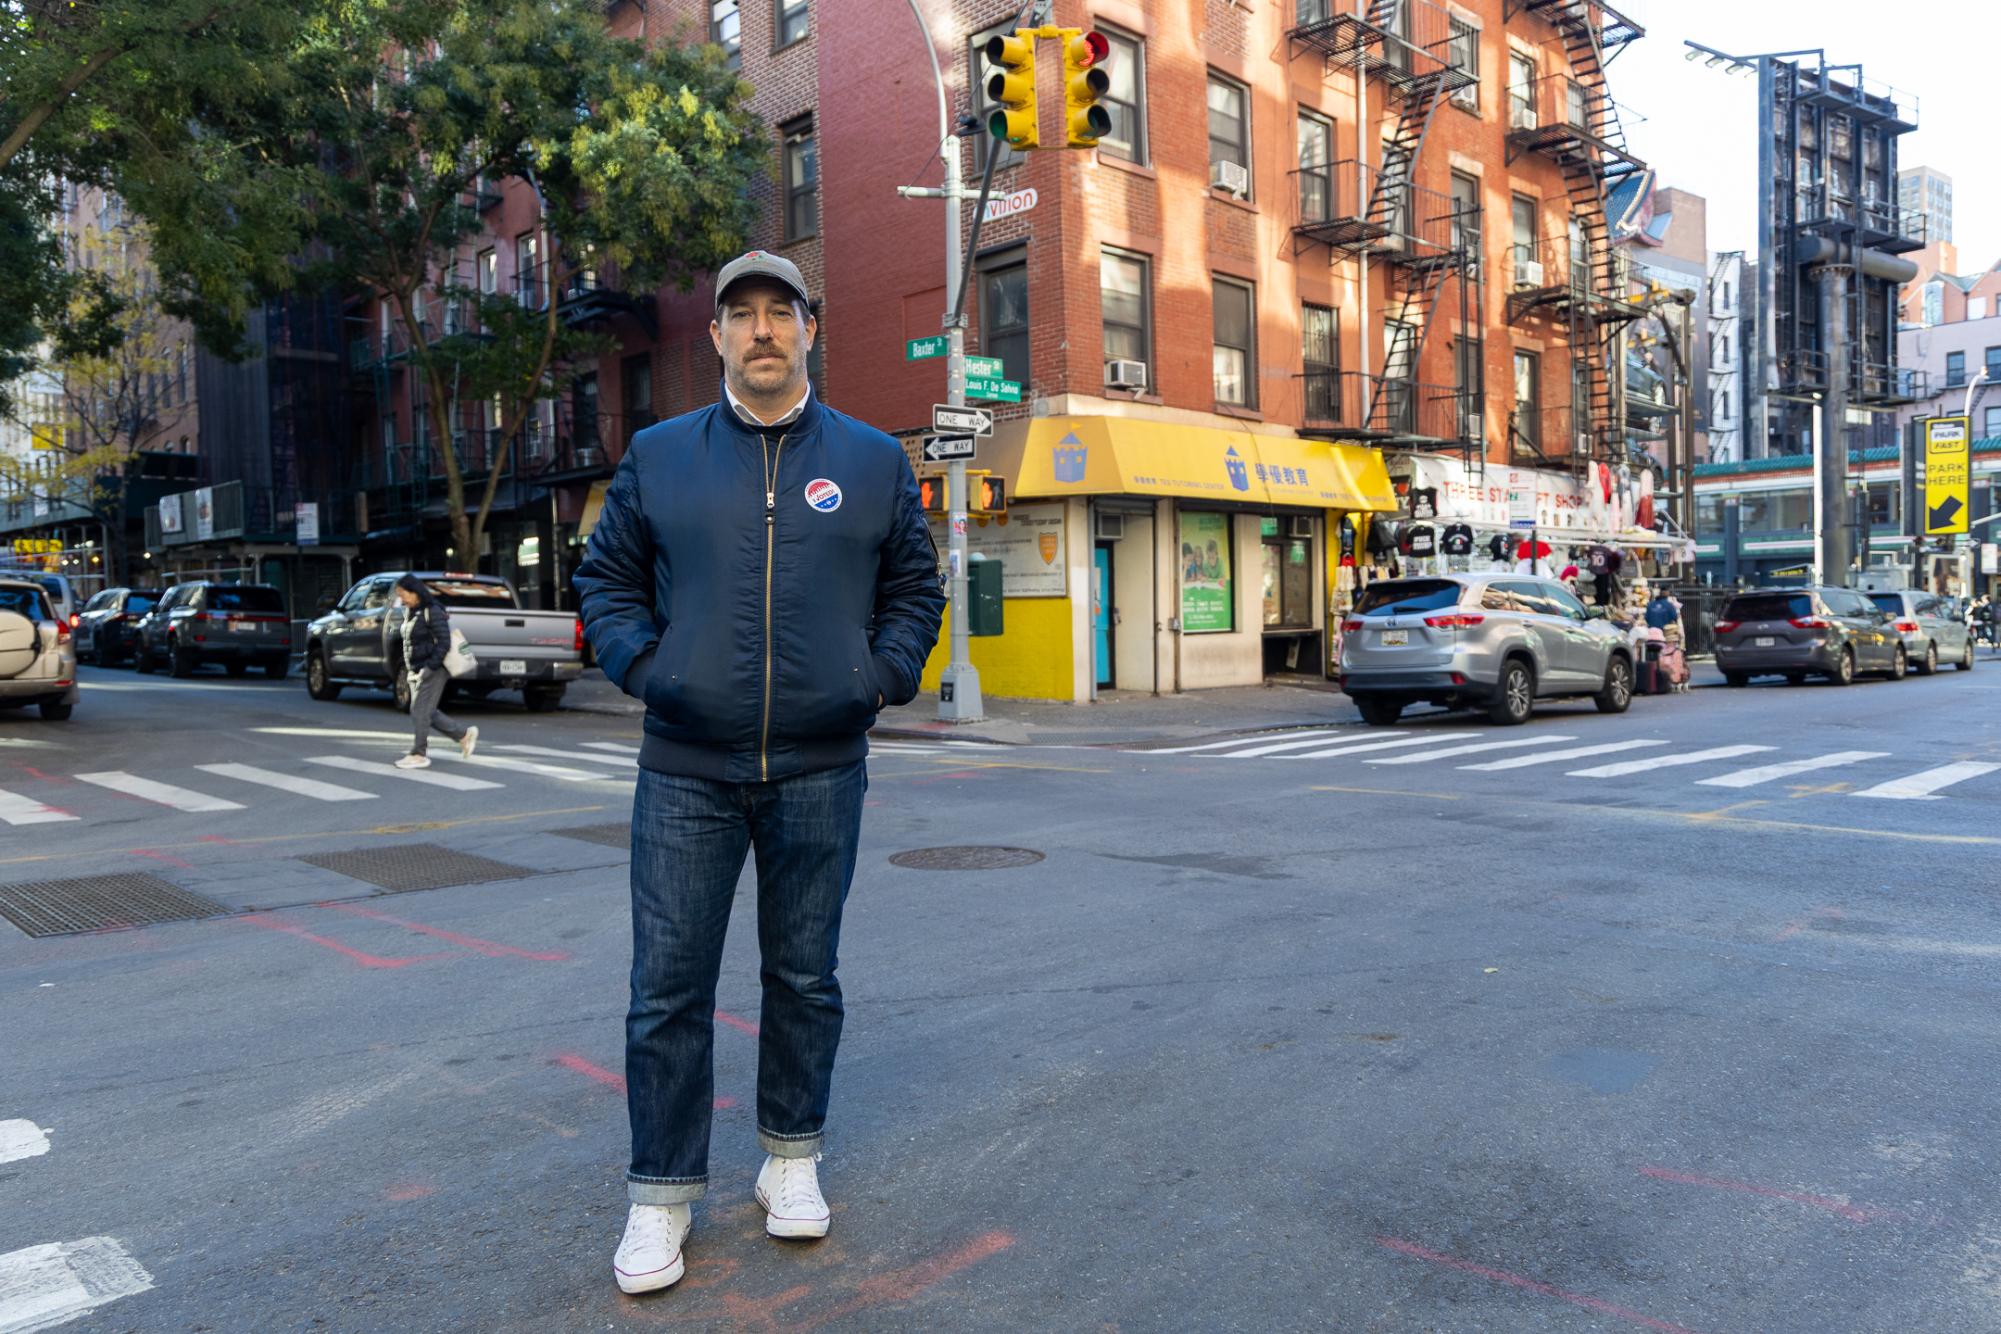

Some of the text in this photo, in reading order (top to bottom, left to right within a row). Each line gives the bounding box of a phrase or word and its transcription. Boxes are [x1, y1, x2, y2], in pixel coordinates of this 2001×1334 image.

[913, 342, 935, 358] Baxter
[966, 358, 992, 376] Hester
[966, 378, 982, 391] Louis
[991, 381, 999, 393] De
[1000, 382, 1019, 395] Salvio
[939, 413, 986, 428] ONE WAY
[932, 440, 969, 454] ONE WAY
[1928, 463, 1966, 473] PARK
[1928, 475, 1967, 486] HERE
[1489, 487, 1510, 503] STA
[1555, 494, 1583, 510] SHOP
